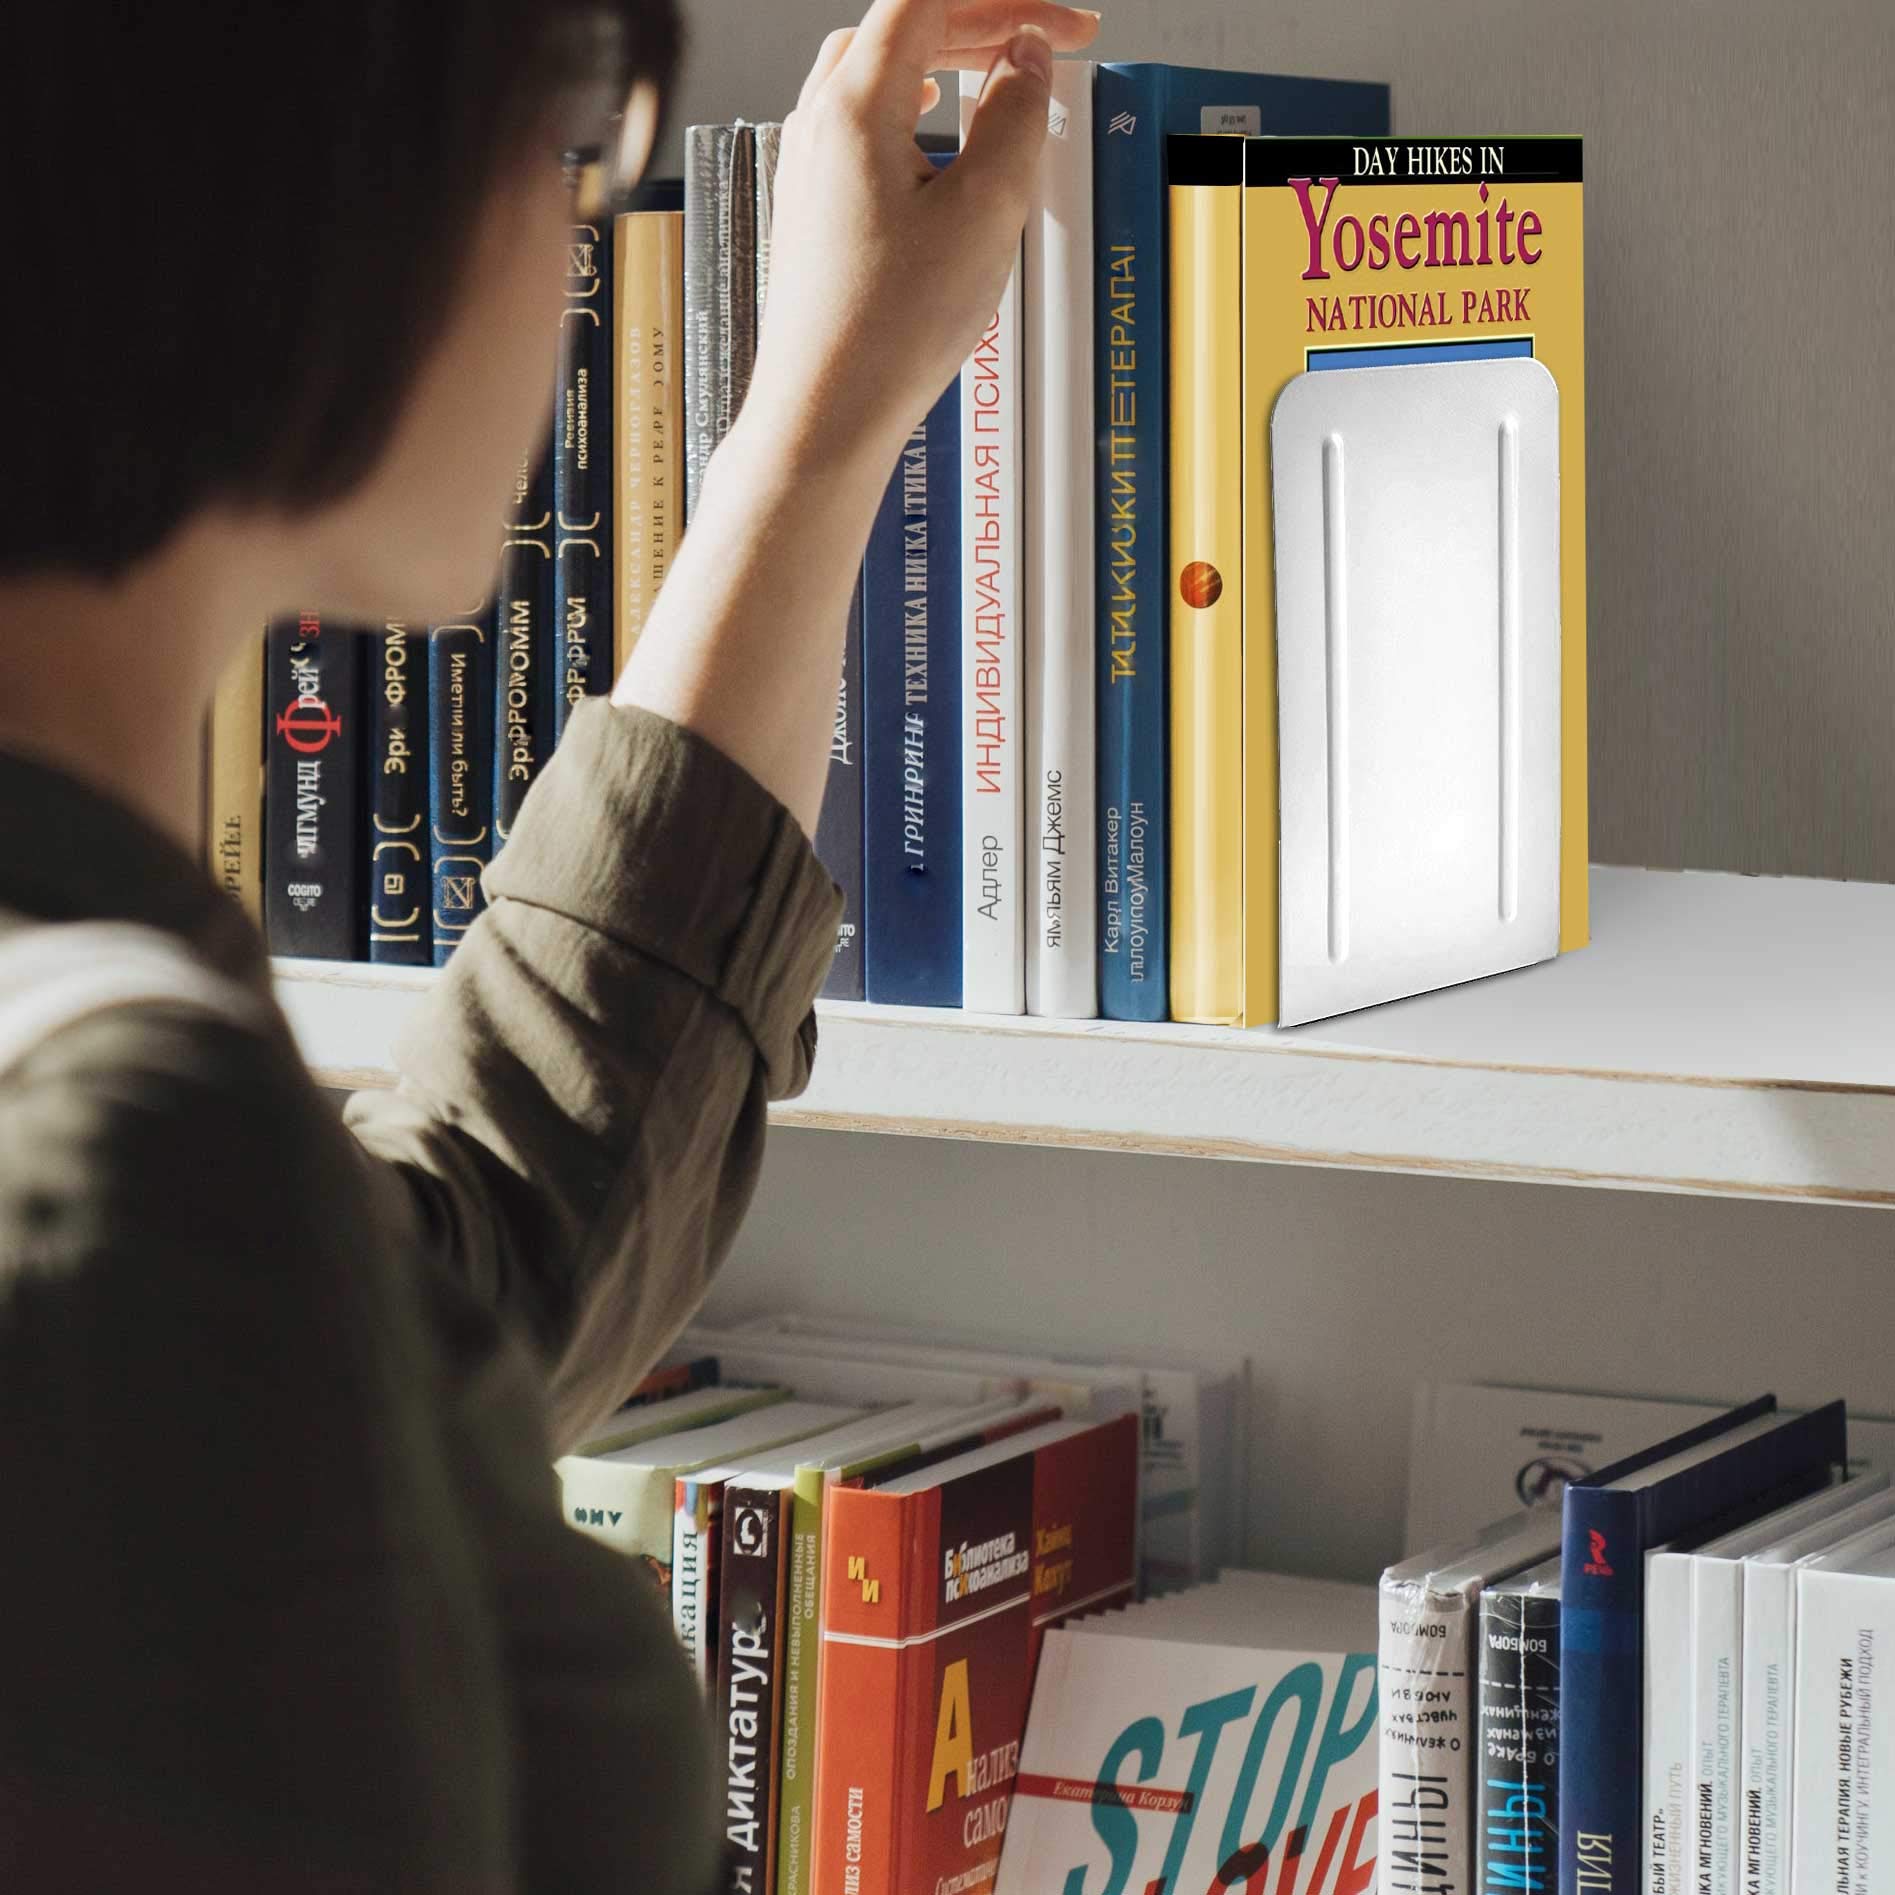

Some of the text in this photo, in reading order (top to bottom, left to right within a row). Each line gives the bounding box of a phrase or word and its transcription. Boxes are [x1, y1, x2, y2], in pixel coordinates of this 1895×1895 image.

[1353, 145, 1505, 176] DAY HIKES IN
[1288, 176, 1543, 281] Yosemite
[1305, 288, 1532, 332] NATIONAL PARK
[577, 367, 589, 470] психоанализа
[904, 597, 928, 706] ТЕХНИКА
[975, 445, 1005, 793] ИНДИВИДУАЛЬНАЯ
[1043, 769, 1066, 855] Джемс
[1105, 806, 1123, 894] Витакер
[977, 835, 1003, 920] Адлер
[791, 1533, 805, 1666] НЕВЫПОЛНЕННЫЕ
[804, 1535, 816, 1620] ОБЕЩАНИЯ
[1840, 1657, 1854, 1719] РУБЕЖИ
[786, 1686, 800, 1781] ОПОЗДАНИЯ
[1839, 1723, 1853, 1771] НОВЫЕ
[846, 1786, 864, 1862] самости
